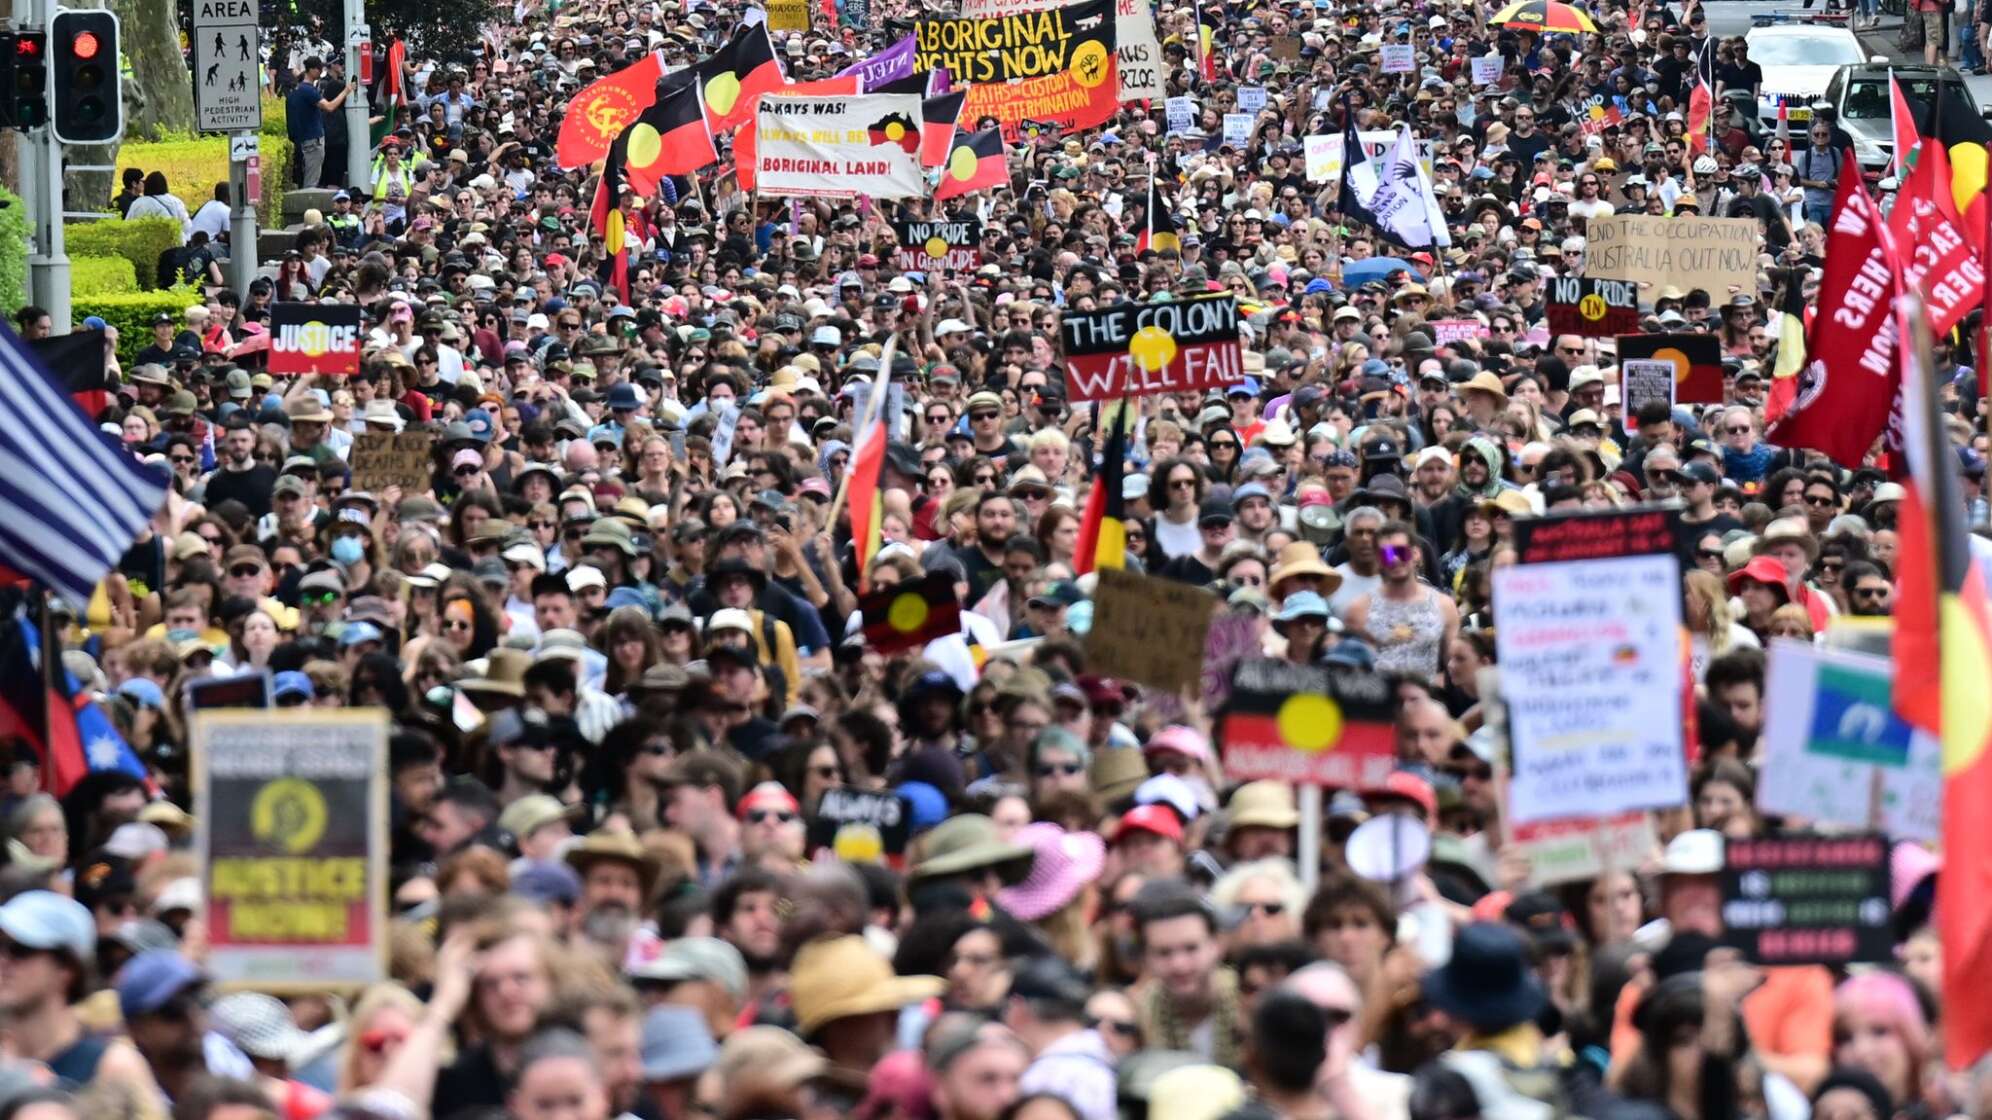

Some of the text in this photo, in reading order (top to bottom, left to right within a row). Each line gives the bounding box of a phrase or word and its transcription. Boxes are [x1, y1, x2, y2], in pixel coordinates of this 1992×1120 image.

[201, 2, 251, 18] AREA
[915, 10, 1072, 51] ABORIGINAL
[1002, 40, 1066, 78] NOW
[1118, 44, 1150, 63] AWS
[967, 84, 1011, 104] DEATHS
[1021, 73, 1071, 98] CUSTODY
[1121, 69, 1156, 88] RZOG
[204, 105, 256, 115] PEDESTRIAN
[219, 97, 240, 105] HIGH
[814, 103, 846, 115] WAS!
[1571, 94, 1604, 116] LAND
[211, 115, 250, 124] ACTIVITY
[762, 158, 891, 175] BORIGINAL LAND!
[909, 223, 972, 245] NO PRIDE
[1588, 220, 1754, 243] END THE OCCUPATION
[900, 250, 915, 270] IN
[1587, 245, 1753, 272] AUSTRALIA OUT NOW
[1555, 279, 1636, 308] NO PRIDE
[1585, 298, 1601, 316] IN
[1063, 300, 1238, 346] THE COLONY
[273, 324, 356, 352] JUSTICE
[1067, 344, 1245, 397] WILL FALL
